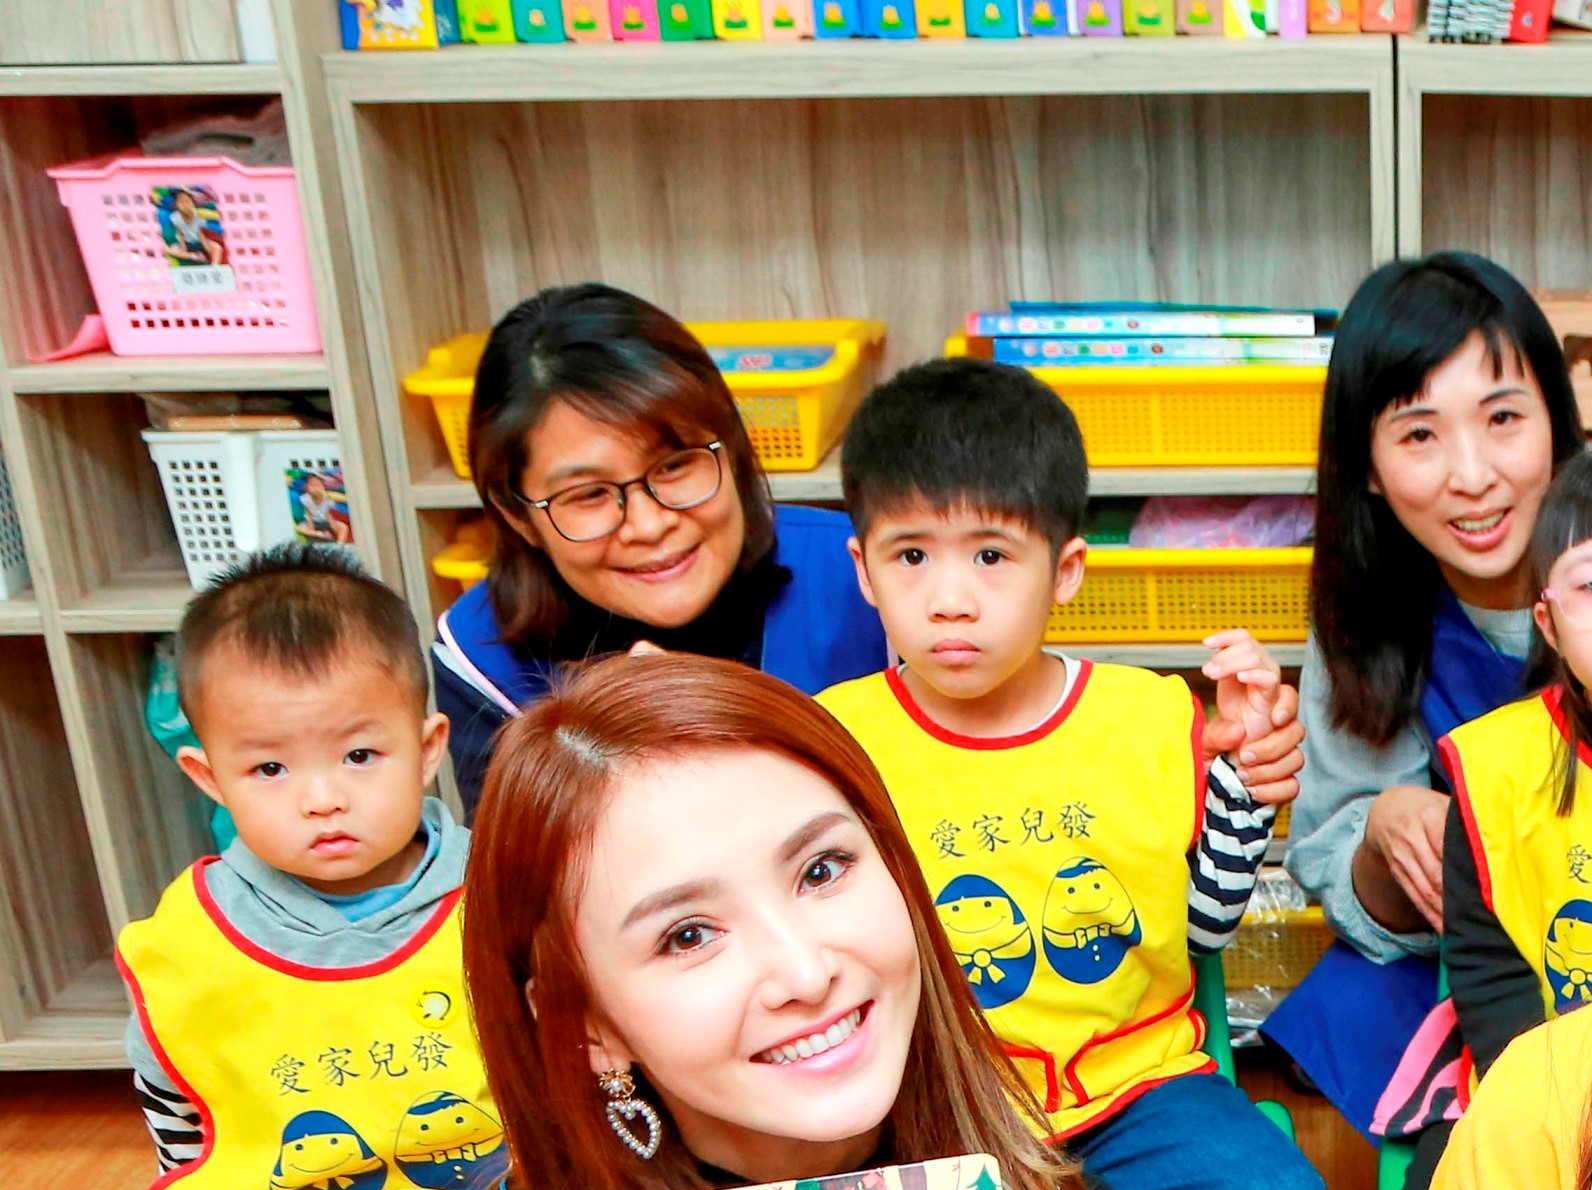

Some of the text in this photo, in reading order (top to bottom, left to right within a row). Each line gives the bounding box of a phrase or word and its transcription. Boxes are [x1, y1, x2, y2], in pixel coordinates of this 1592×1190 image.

[930, 800, 1097, 860] 愛家兒發
[270, 1031, 454, 1096] 愛家兒發
